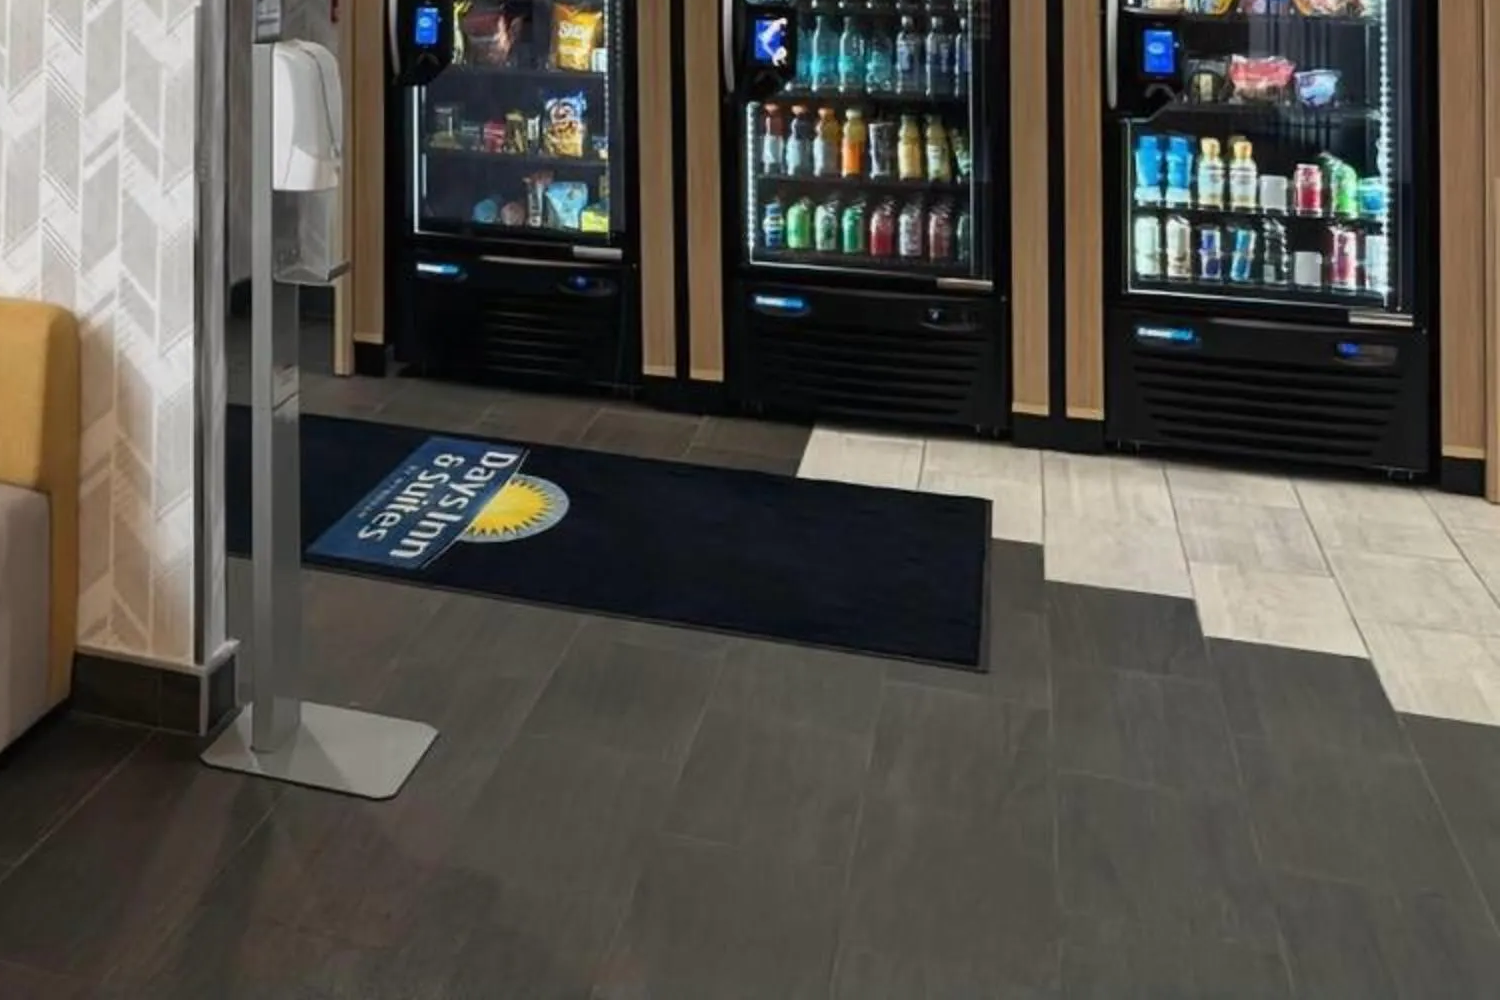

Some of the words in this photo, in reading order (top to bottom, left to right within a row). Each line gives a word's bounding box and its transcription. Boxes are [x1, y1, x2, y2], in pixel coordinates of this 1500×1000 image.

[433, 453, 465, 468] &
[438, 451, 519, 510] Days
[357, 470, 450, 541] Suites
[389, 511, 462, 558] Inn
